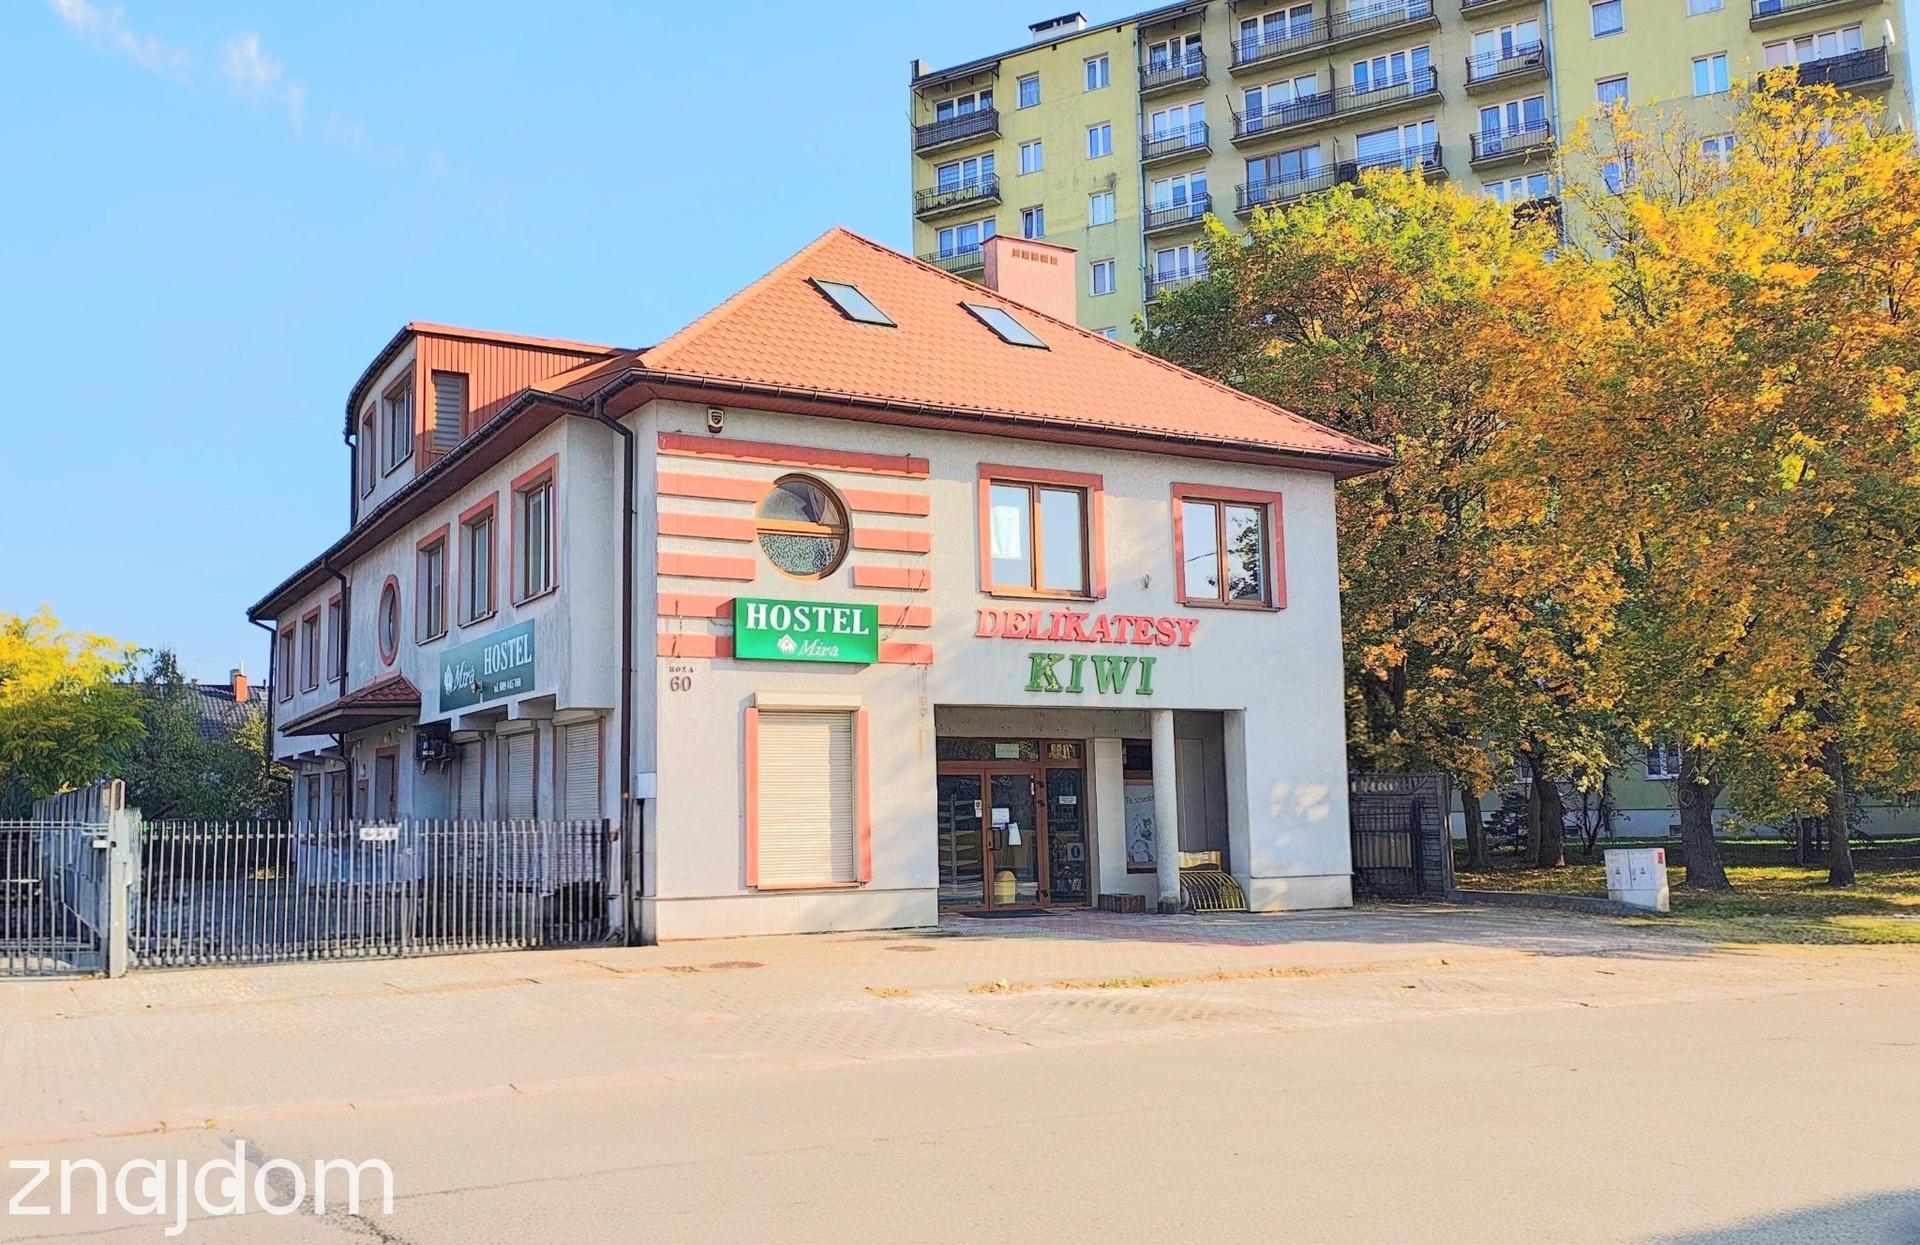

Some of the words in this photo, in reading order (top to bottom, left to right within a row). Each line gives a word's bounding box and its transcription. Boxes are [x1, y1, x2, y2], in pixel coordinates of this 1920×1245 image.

[746, 602, 869, 635] HOSTEL
[975, 607, 1199, 647] DELIKATESY
[484, 633, 532, 676] HOSTEL
[797, 638, 840, 657] Mira
[452, 660, 476, 691] Mira
[670, 676, 692, 692] 60
[1024, 652, 1157, 695] KIWI
